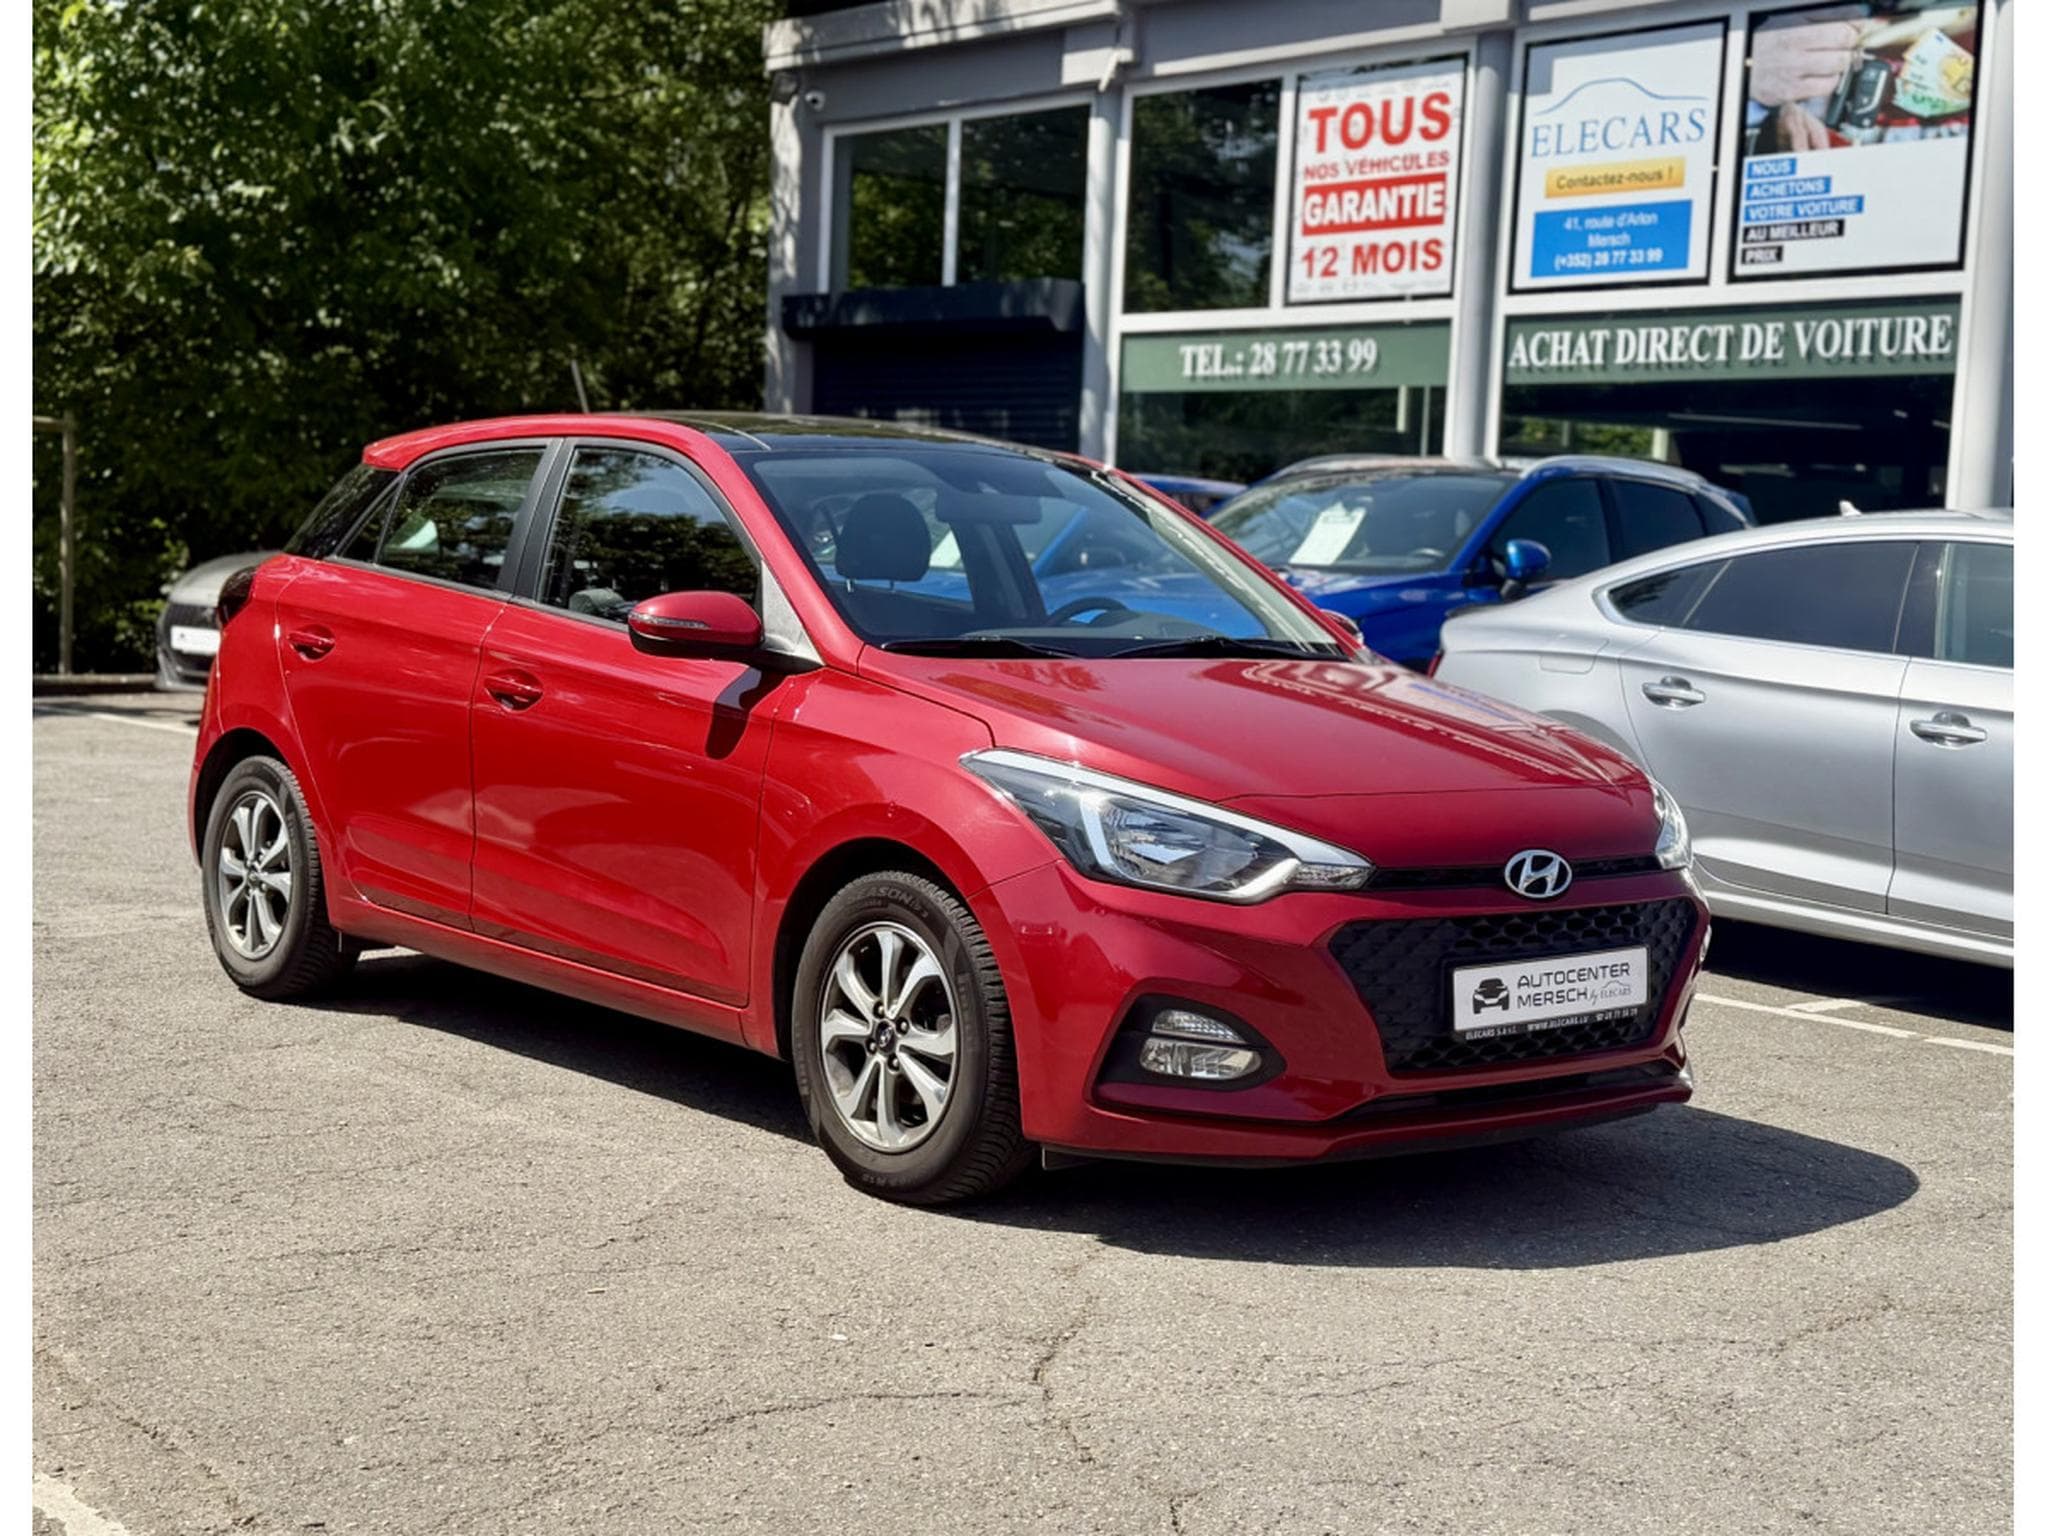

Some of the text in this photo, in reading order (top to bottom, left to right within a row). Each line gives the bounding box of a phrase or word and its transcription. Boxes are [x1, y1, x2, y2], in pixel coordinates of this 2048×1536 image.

[1308, 91, 1452, 154] TOUS
[1531, 108, 1706, 158] ELECARS
[1304, 163, 1339, 181] NOS
[1556, 167, 1663, 190] Contactez-nous
[1752, 160, 1790, 176] NOUS
[1749, 179, 1825, 198] ACHETONS
[1304, 182, 1446, 228] GARANTIE
[1749, 198, 1858, 220] VOTRE VOITURE
[1746, 221, 1839, 241] AU MEILLEUR
[1302, 239, 1443, 279] 12 MOIS
[1744, 247, 1778, 263] PRIX
[1507, 315, 1952, 368] ACHAT DIRECT DE VOITURE
[1249, 342, 1276, 375] 28
[1282, 341, 1309, 374] 77
[1313, 340, 1342, 373] 33
[1349, 338, 1378, 372] 99
[1517, 962, 1631, 989] AUTOCENTER
[1517, 987, 1588, 1009] MERSCH
